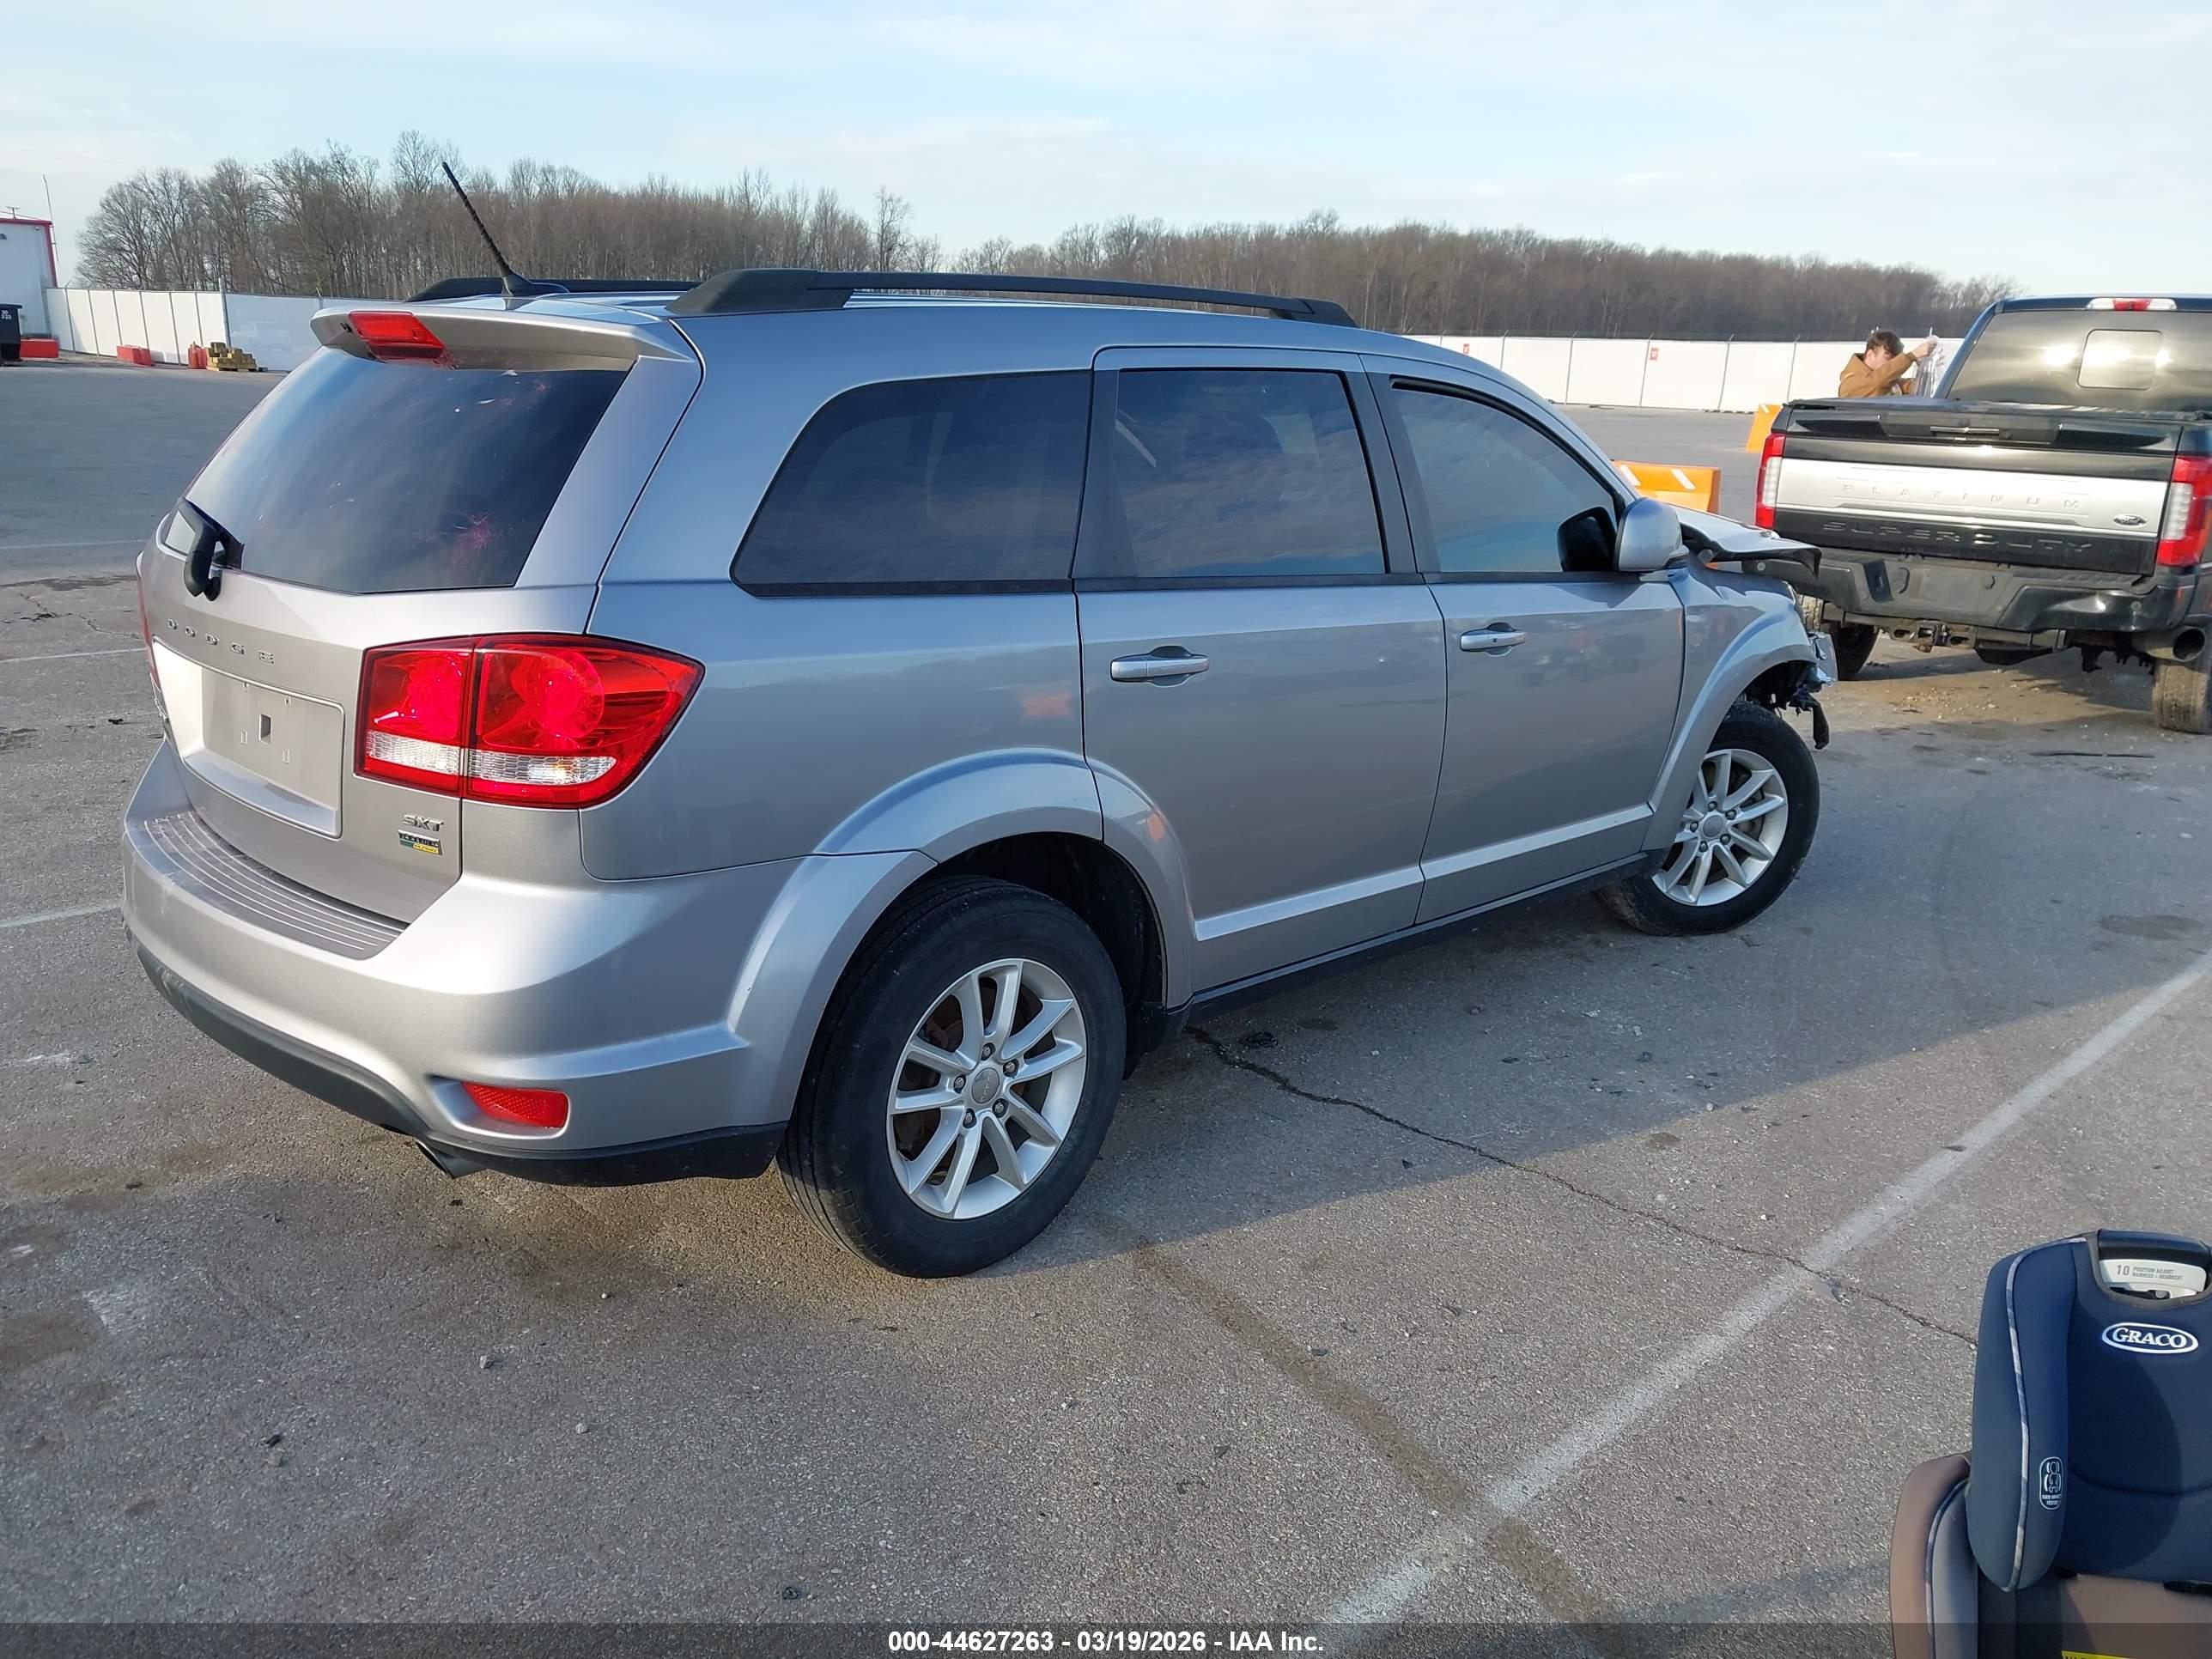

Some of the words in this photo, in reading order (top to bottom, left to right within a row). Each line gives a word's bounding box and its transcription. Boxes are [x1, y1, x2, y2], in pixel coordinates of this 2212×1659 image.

[1842, 483, 2080, 508] PLATINUM
[1823, 521, 1961, 543] SUPER
[1974, 532, 2093, 552] DUTY
[167, 618, 275, 665] DODGE
[403, 814, 444, 832] SXT
[2117, 1264, 2130, 1276] 10
[2112, 1327, 2187, 1348] GRACO
